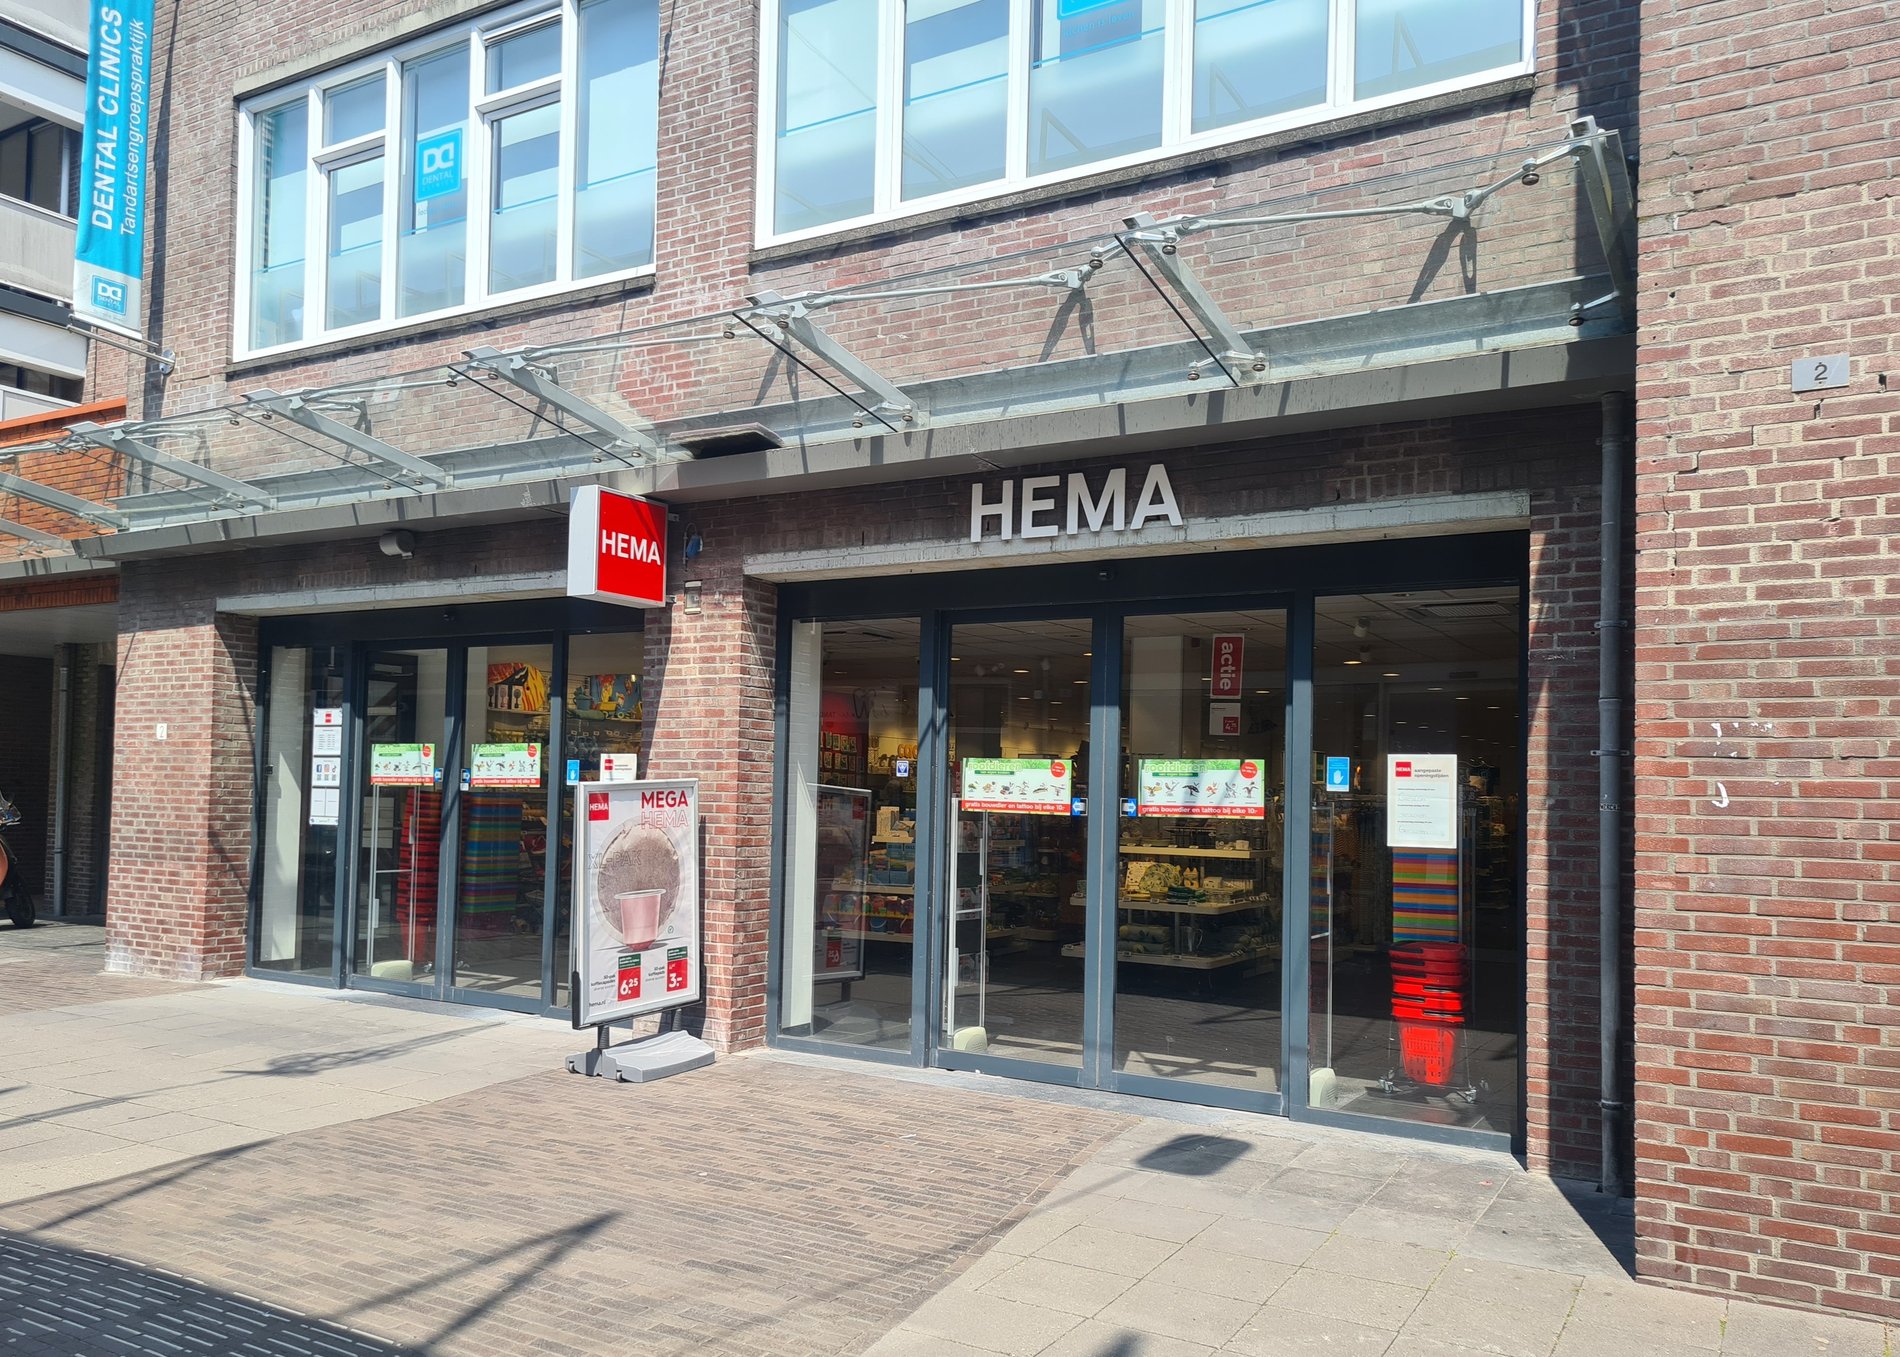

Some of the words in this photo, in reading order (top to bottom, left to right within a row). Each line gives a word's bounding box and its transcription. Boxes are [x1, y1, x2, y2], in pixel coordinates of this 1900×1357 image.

[98, 6, 123, 115] CLINICS
[120, 18, 147, 237] Tandartsengroepspraktijk
[92, 124, 118, 231] DENTAL
[423, 170, 454, 186] DENTAL
[1814, 363, 1828, 381] 2
[970, 463, 1184, 543] HEMA
[601, 529, 662, 567] HEMA
[1220, 641, 1237, 691] actie
[1144, 761, 1206, 772] roofdieren
[589, 803, 609, 811] HEMA
[641, 790, 689, 809] MEGA
[641, 810, 689, 830] HEMA
[1222, 807, 1231, 815] bij
[588, 850, 641, 870] XL-PAK
